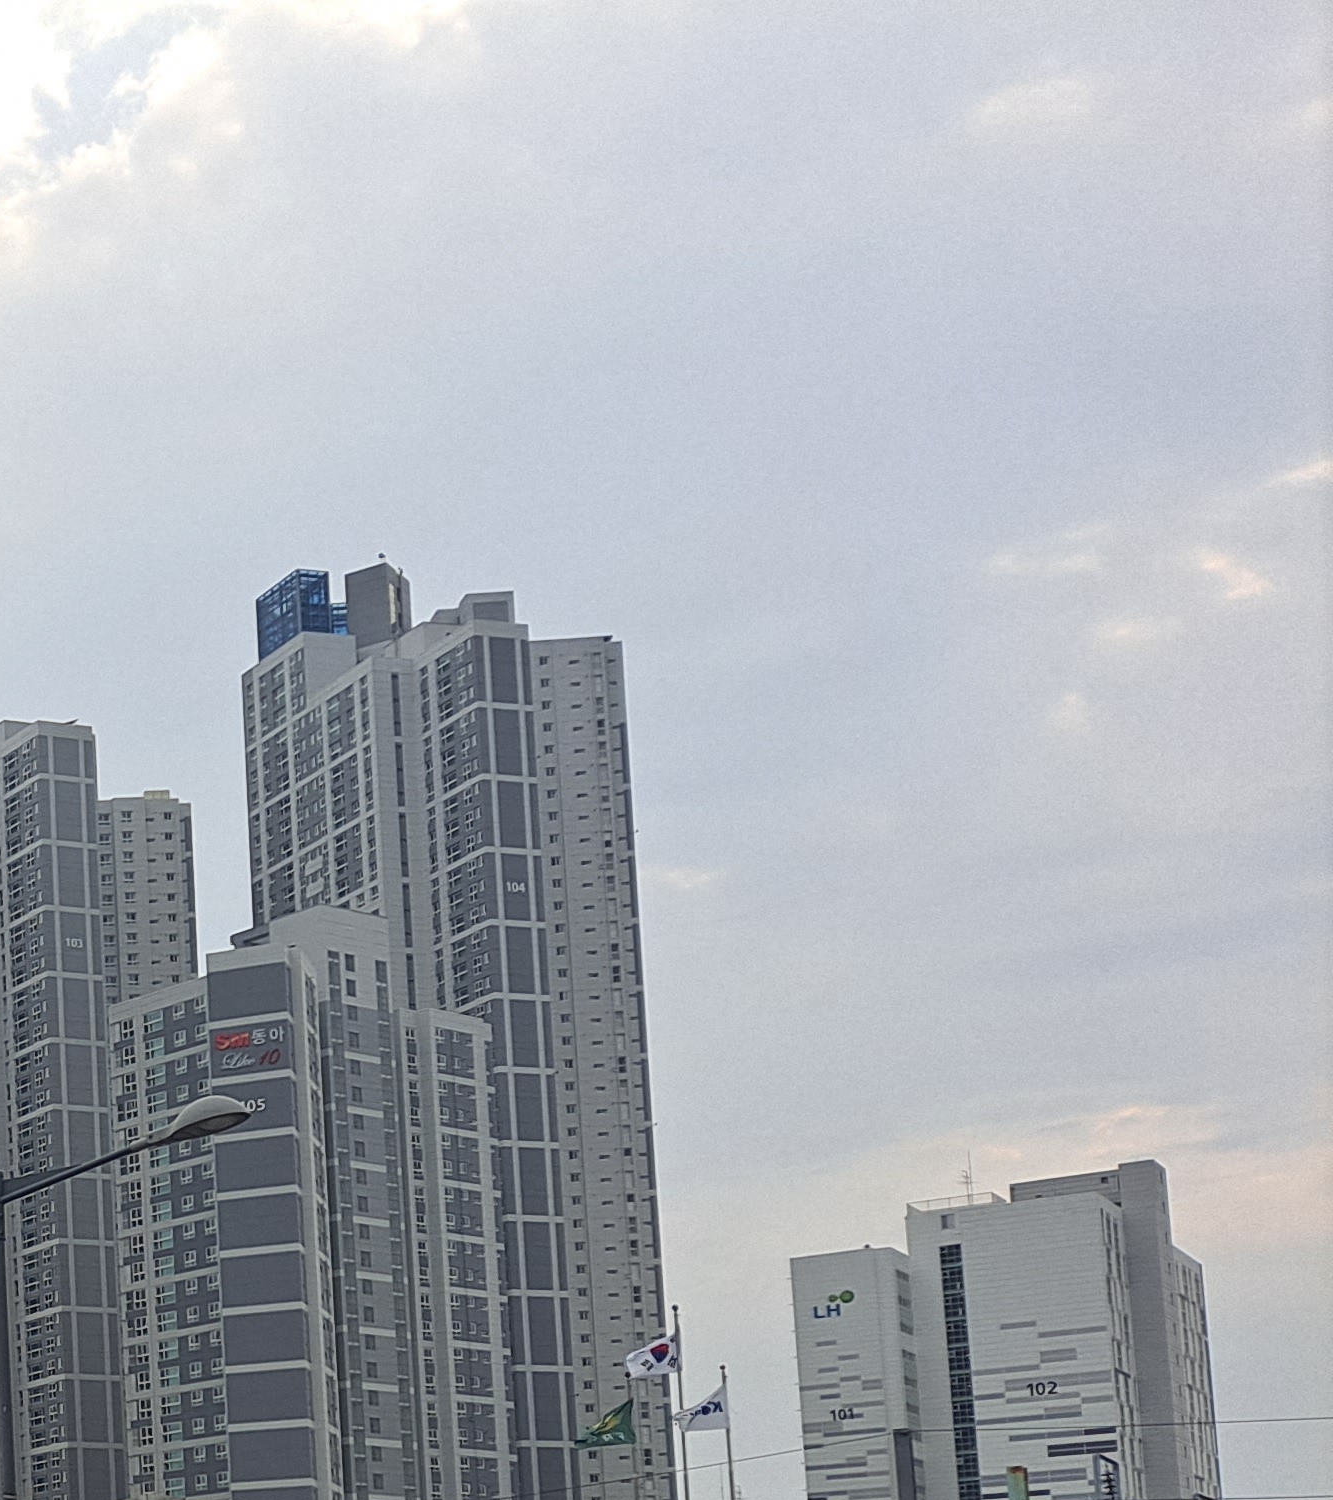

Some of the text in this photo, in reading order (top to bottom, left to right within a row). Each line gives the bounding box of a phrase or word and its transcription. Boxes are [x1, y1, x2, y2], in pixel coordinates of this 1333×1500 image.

[505, 881, 526, 893] 104
[65, 937, 83, 949] 103
[252, 1025, 284, 1045] 동아
[259, 1048, 281, 1065] 10
[813, 1303, 842, 1319] LH
[1025, 1380, 1058, 1397] 102
[829, 1407, 856, 1421] 101
